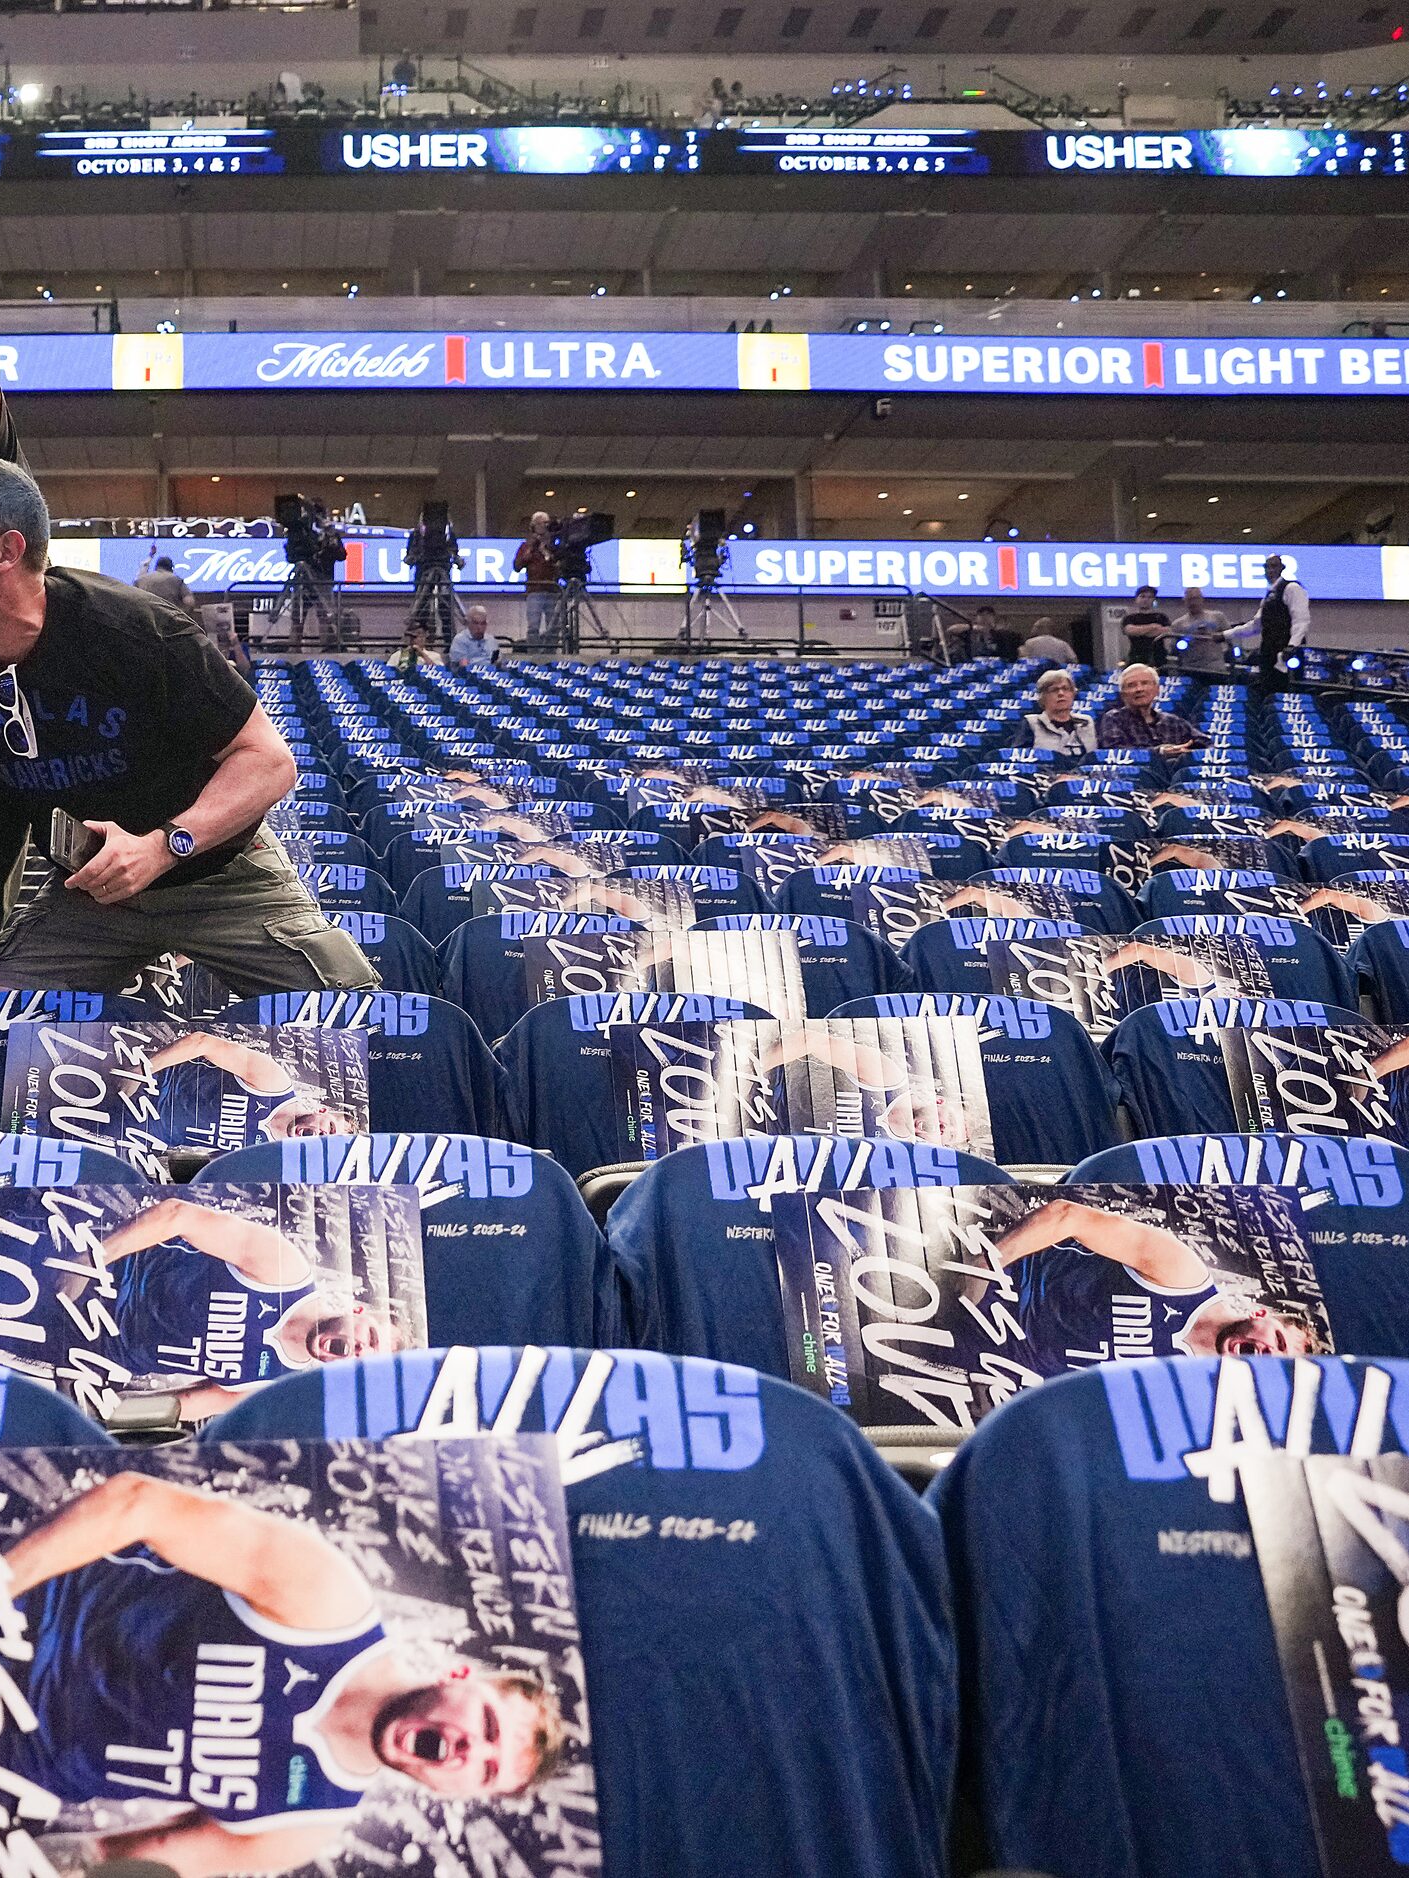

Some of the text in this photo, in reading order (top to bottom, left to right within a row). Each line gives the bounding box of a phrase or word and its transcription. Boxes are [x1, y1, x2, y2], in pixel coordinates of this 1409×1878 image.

[76, 158, 167, 175] OCTOBER
[193, 158, 207, 172] 4
[210, 158, 225, 172] &
[230, 158, 240, 172] 5
[343, 134, 486, 168] USHER
[779, 155, 870, 172] OCTOBER
[898, 156, 910, 170] 4
[914, 156, 930, 171] &
[934, 156, 944, 171] 5
[1046, 136, 1192, 169] USHER
[257, 343, 436, 383] Michelob
[884, 344, 1132, 384] SUPERIOR
[1175, 347, 1325, 387] LIGHT
[756, 550, 988, 587] SUPERIOR
[1028, 552, 1167, 589] LIGHT
[185, 1122, 216, 1146] 77
[627, 1115, 637, 1142] chime
[814, 1261, 842, 1345] ONE FOR
[157, 1337, 202, 1372] 77
[802, 1332, 817, 1374] chime
[323, 1345, 767, 1488] DALLAS
[1332, 1585, 1400, 1745] ONE FOR
[105, 1729, 185, 1797] 77
